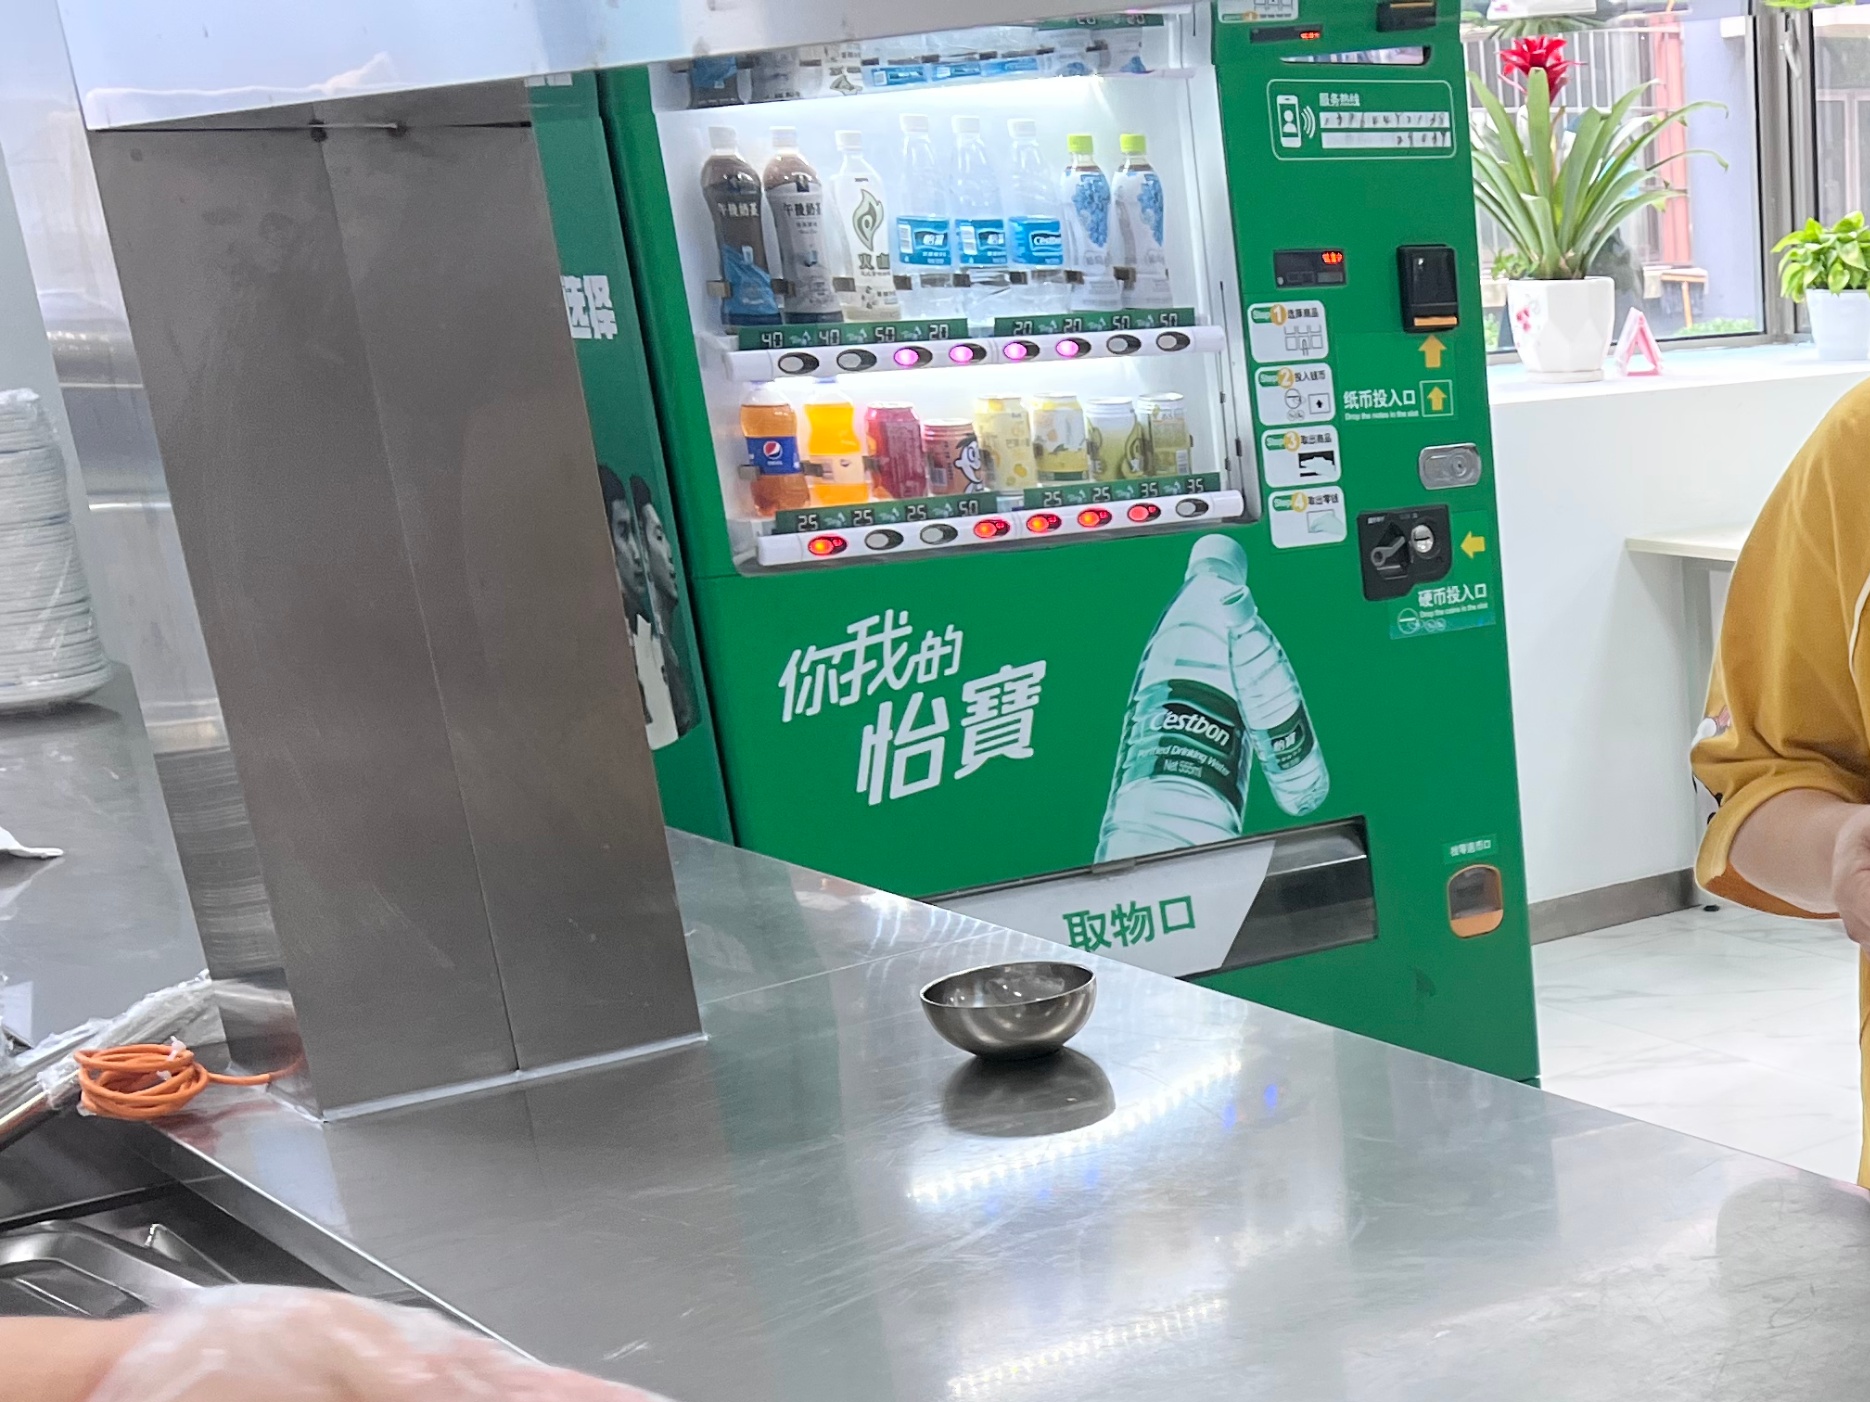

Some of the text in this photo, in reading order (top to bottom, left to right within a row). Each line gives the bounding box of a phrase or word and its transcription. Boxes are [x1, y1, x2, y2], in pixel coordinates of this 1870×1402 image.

[761, 324, 949, 348] 40 40 50 20
[1013, 313, 1177, 335] 20 20 50 50
[1343, 389, 1416, 409] 纸币投入口
[1044, 479, 1204, 507] 25 25 35 35
[798, 500, 978, 531] 25 25 25 50
[1418, 583, 1487, 607] 硬币投入口
[778, 609, 963, 723] 你我的
[856, 660, 1046, 806] 怡寶
[1151, 711, 1230, 746] C'estbon
[1170, 745, 1208, 764] Drinking
[1207, 756, 1231, 777] Water
[1063, 896, 1197, 954] 取物口
